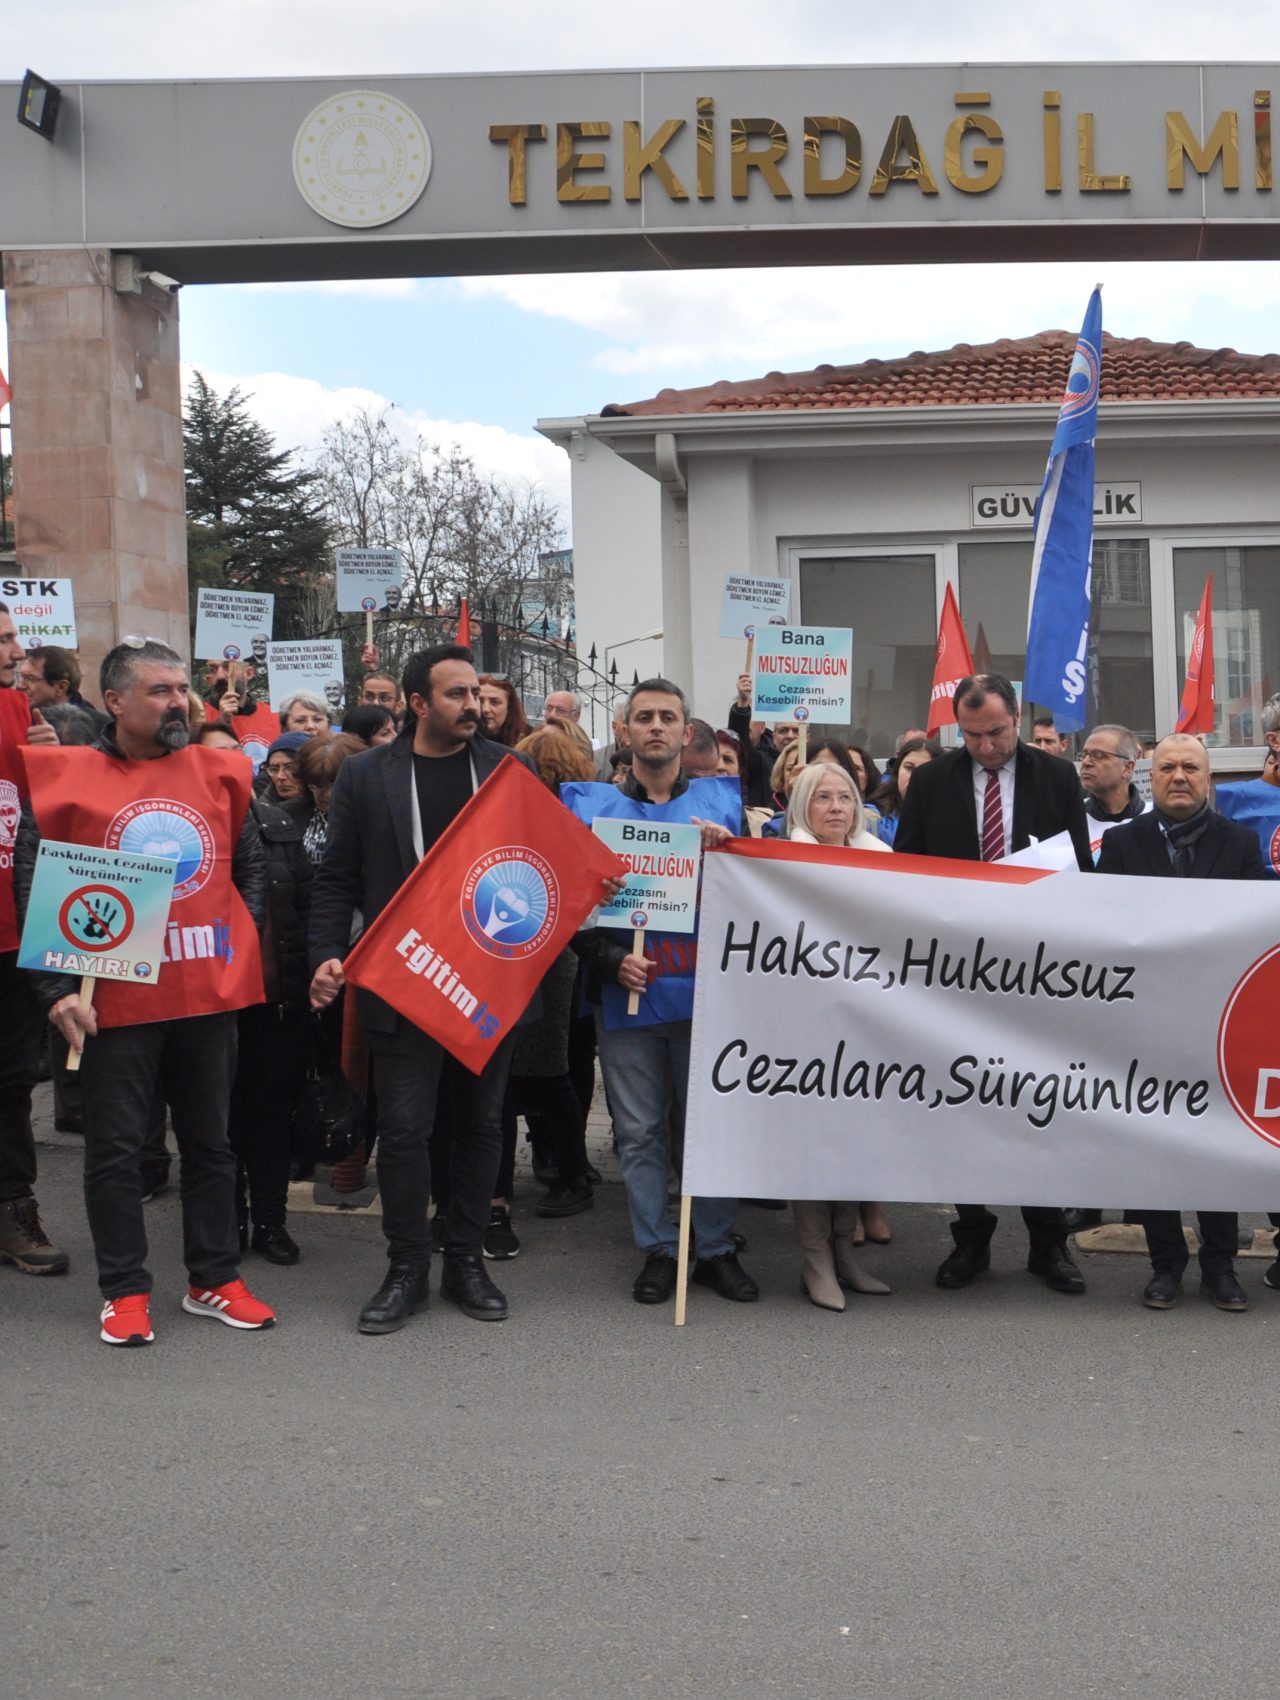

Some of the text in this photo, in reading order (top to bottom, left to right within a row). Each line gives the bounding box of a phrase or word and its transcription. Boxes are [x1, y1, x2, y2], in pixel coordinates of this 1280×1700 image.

[489, 91, 1005, 206] TEKİRDAĞ
[1042, 90, 1132, 195] İL
[977, 489, 1137, 518] GÜVİK
[2, 580, 59, 597] STK
[13, 604, 53, 617] değil
[16, 622, 73, 635] RİKAT
[782, 630, 825, 645] Bana
[758, 654, 848, 676] MUTSUZLUĞUN
[778, 684, 824, 694] Cezasını
[757, 694, 845, 706] Kesebilir misin?
[622, 825, 671, 843] Bana
[68, 864, 143, 885] Sürgünlere
[114, 857, 173, 876] Cezalara
[465, 866, 483, 900] EĞİTİM
[483, 856, 494, 868] VE
[495, 850, 524, 861] BİLİM
[608, 898, 688, 912] sebilir misin?
[44, 950, 130, 976] HAYIR!
